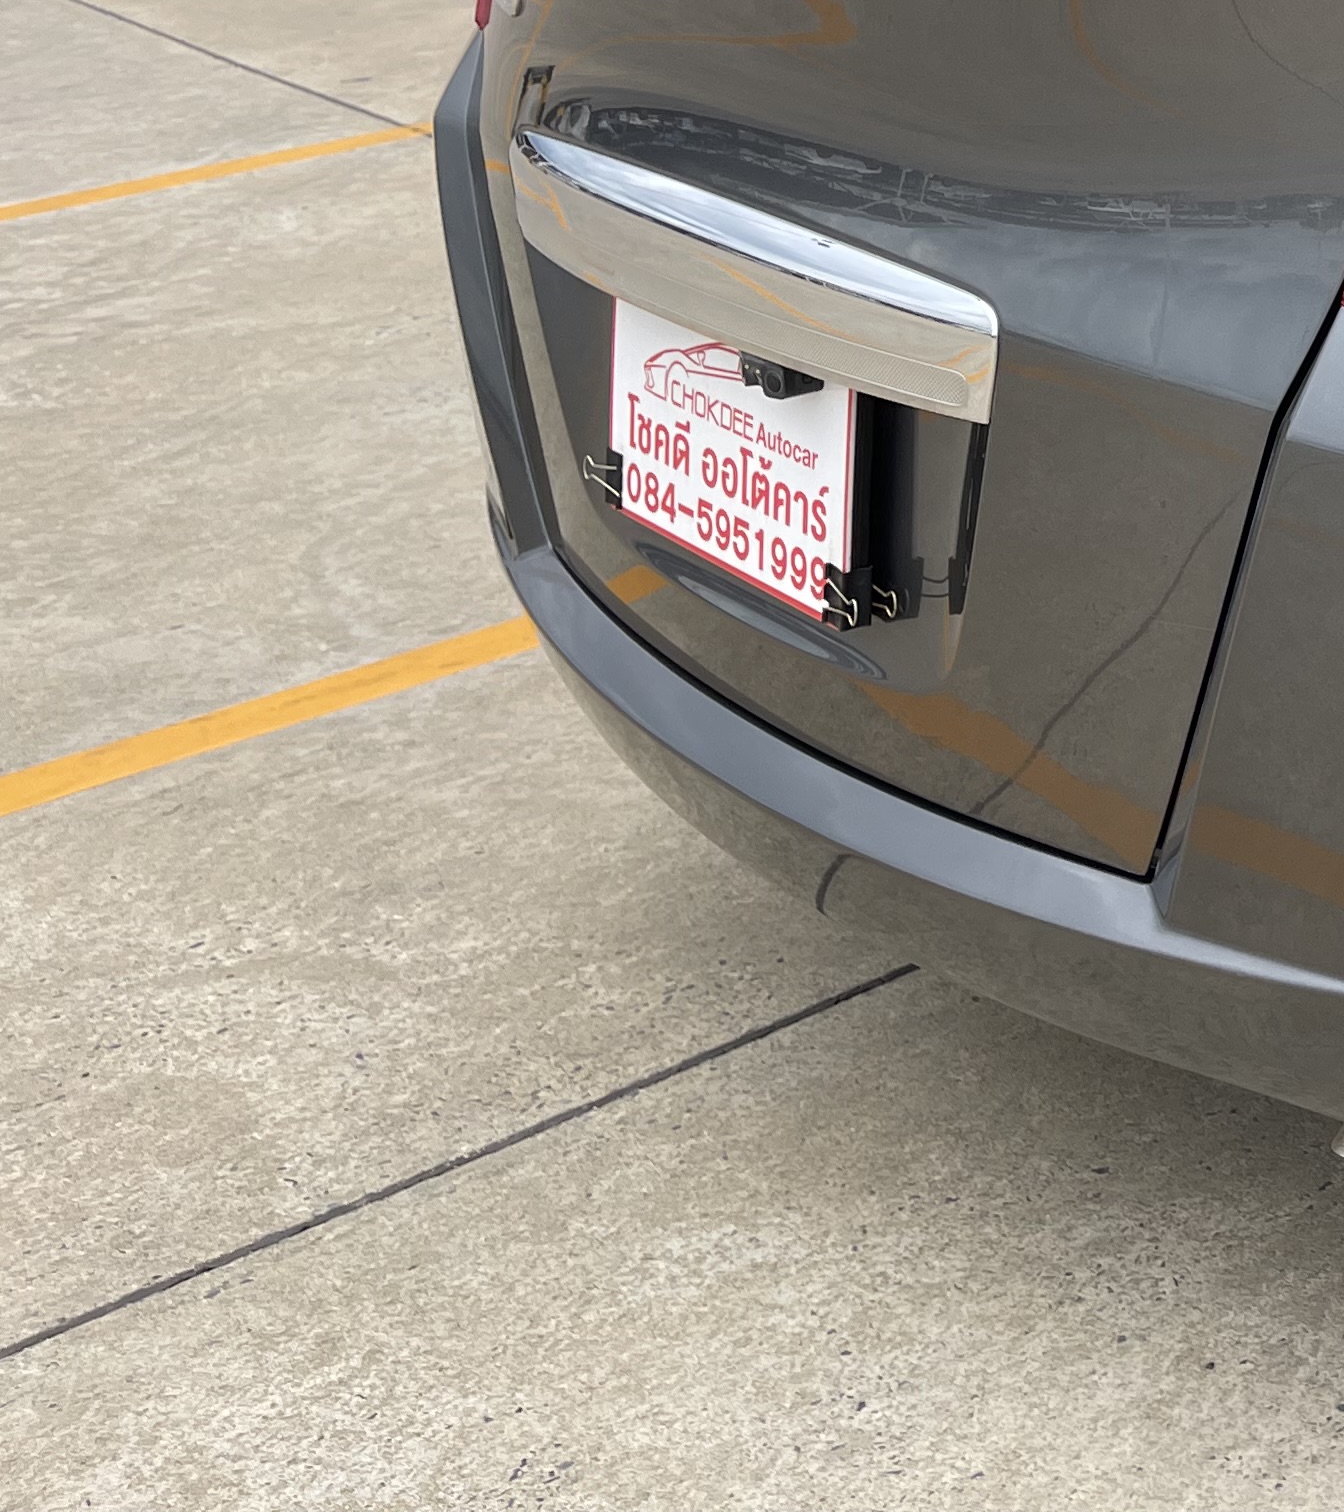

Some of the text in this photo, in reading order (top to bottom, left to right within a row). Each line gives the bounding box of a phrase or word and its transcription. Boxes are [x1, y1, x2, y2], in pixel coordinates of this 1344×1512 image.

[627, 392, 829, 542] โชคดี ออโต้คาร์
[670, 379, 819, 471] CHOKDEE Autocar
[626, 462, 825, 601] 084-5951999
